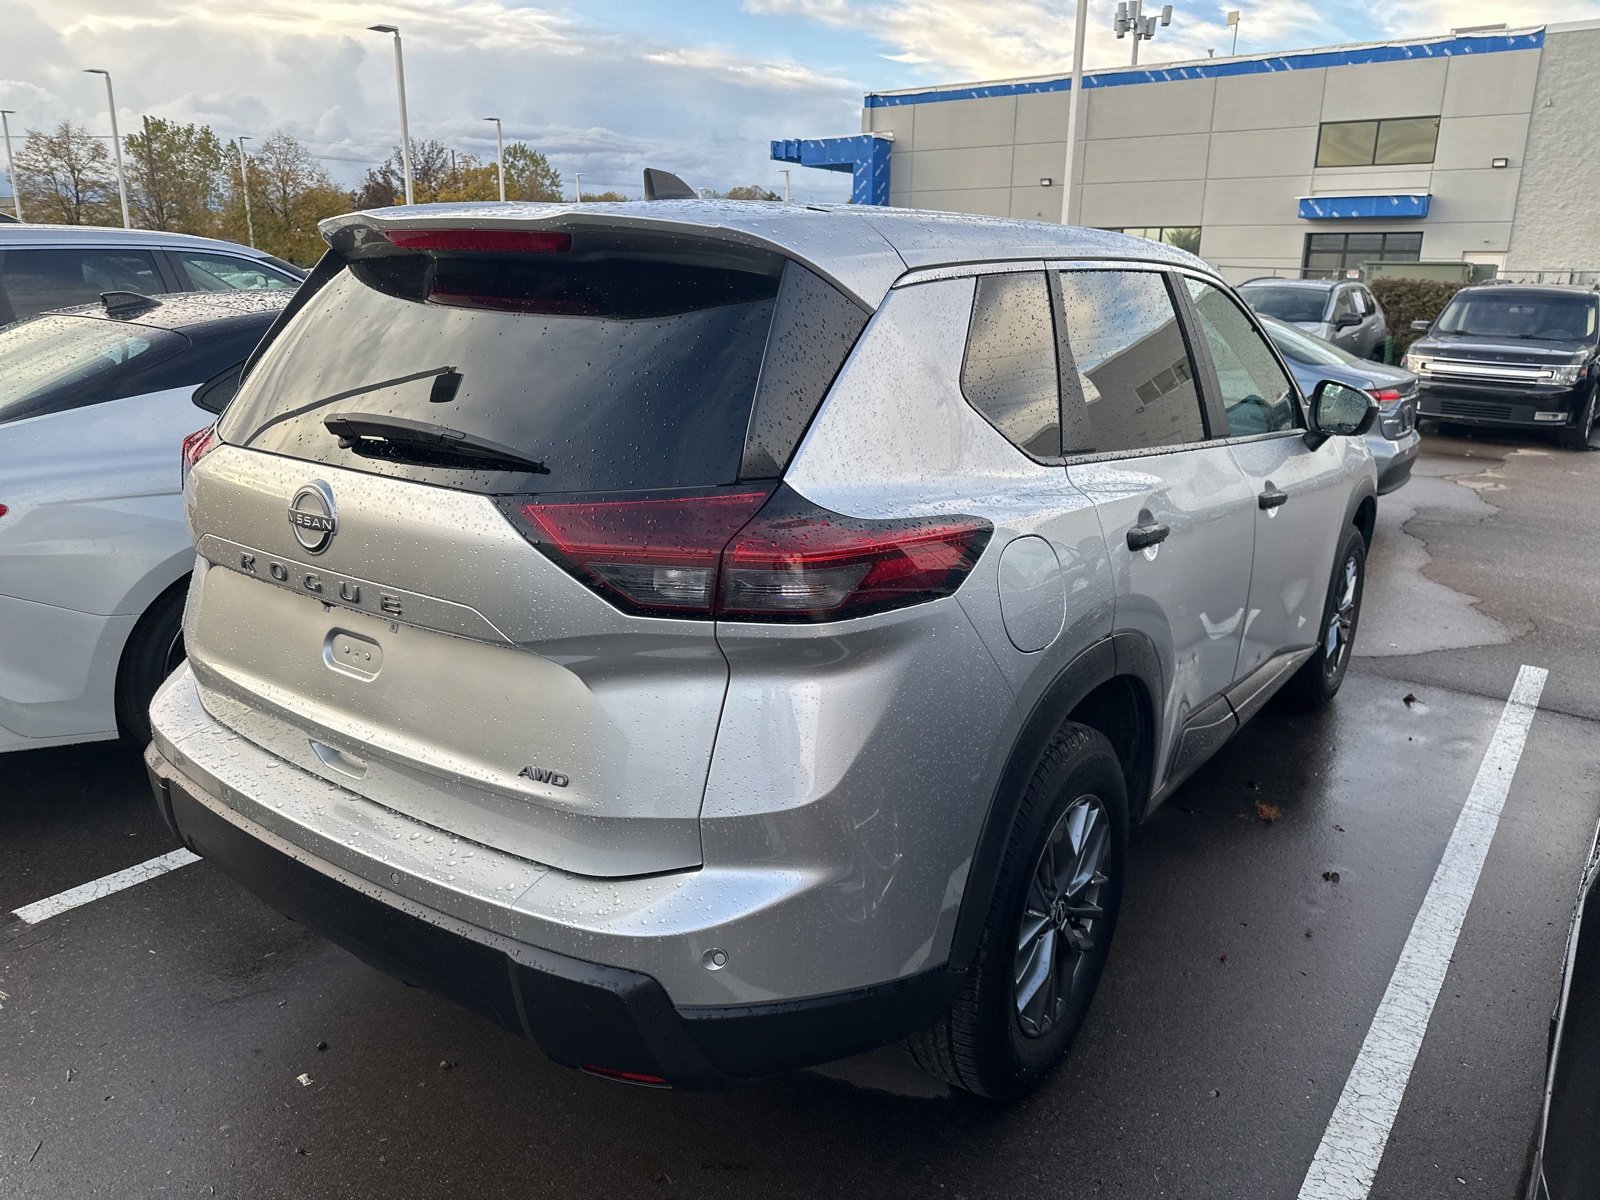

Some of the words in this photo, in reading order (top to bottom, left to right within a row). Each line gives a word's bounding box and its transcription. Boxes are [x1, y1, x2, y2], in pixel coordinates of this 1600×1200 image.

[288, 510, 332, 530] NISSAN
[240, 551, 402, 616] ROGUE
[517, 765, 569, 788] AWD
